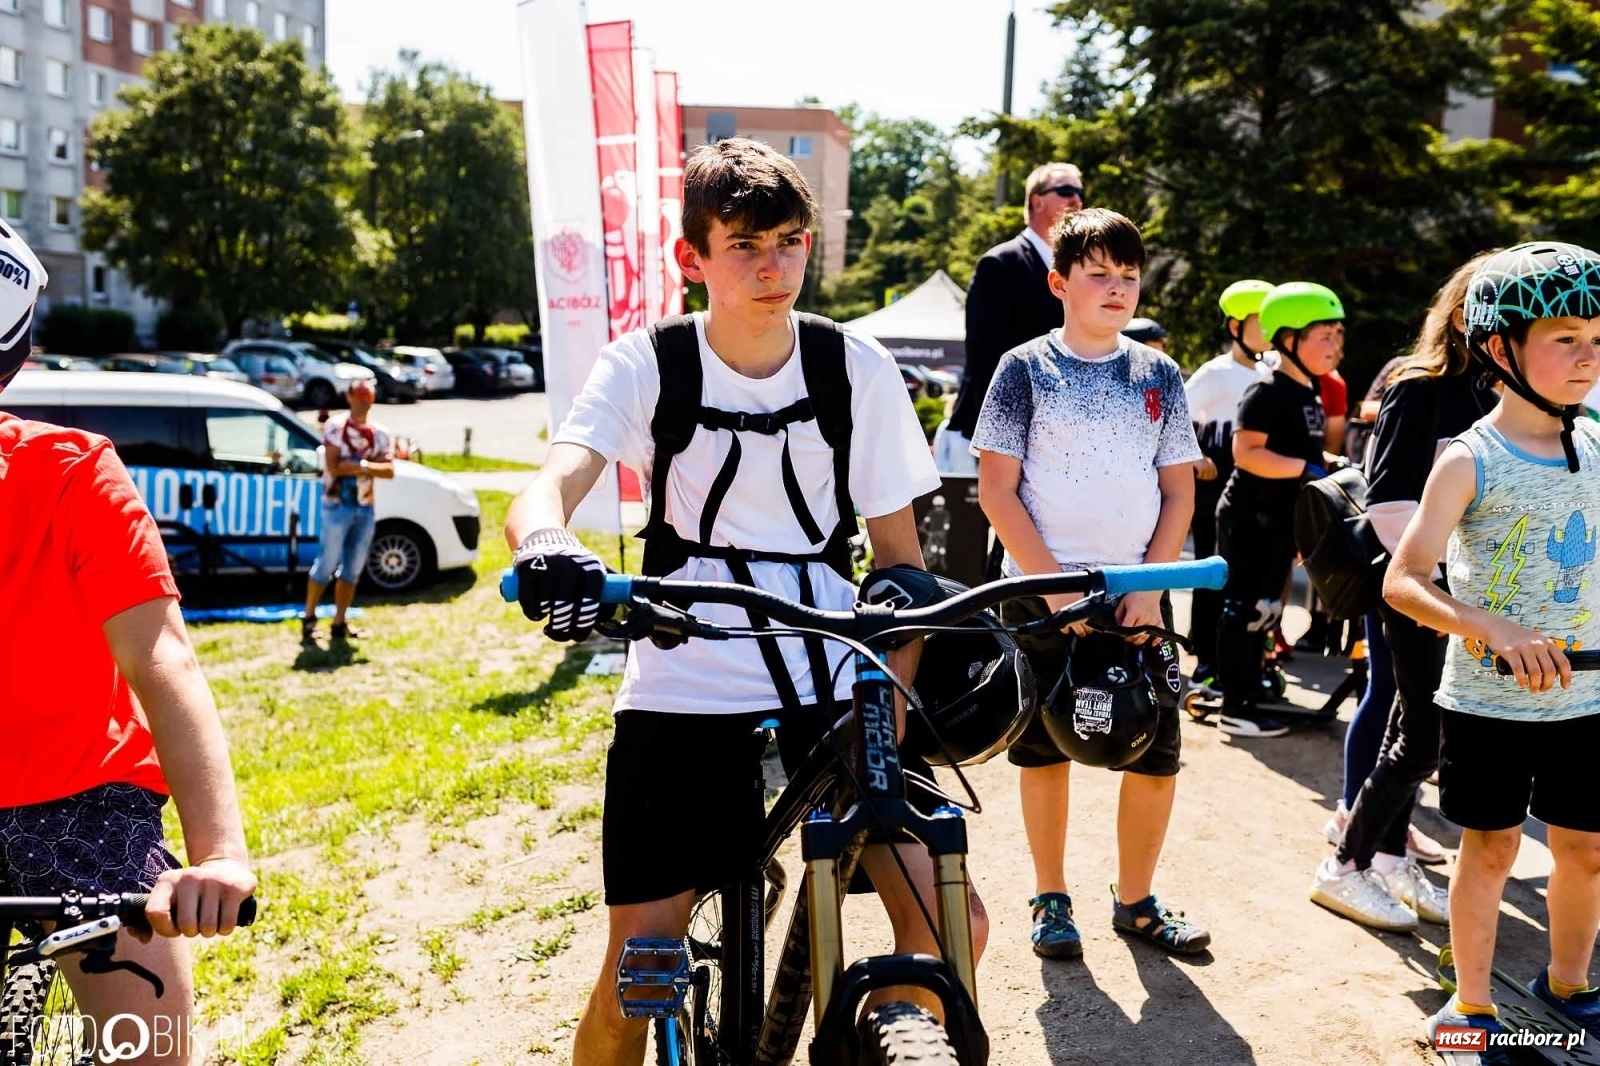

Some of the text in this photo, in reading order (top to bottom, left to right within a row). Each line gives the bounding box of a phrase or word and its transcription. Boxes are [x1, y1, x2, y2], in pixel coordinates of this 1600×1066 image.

[1075, 698, 1113, 712] DRIFT TEAM
[63, 928, 91, 940] SLX
